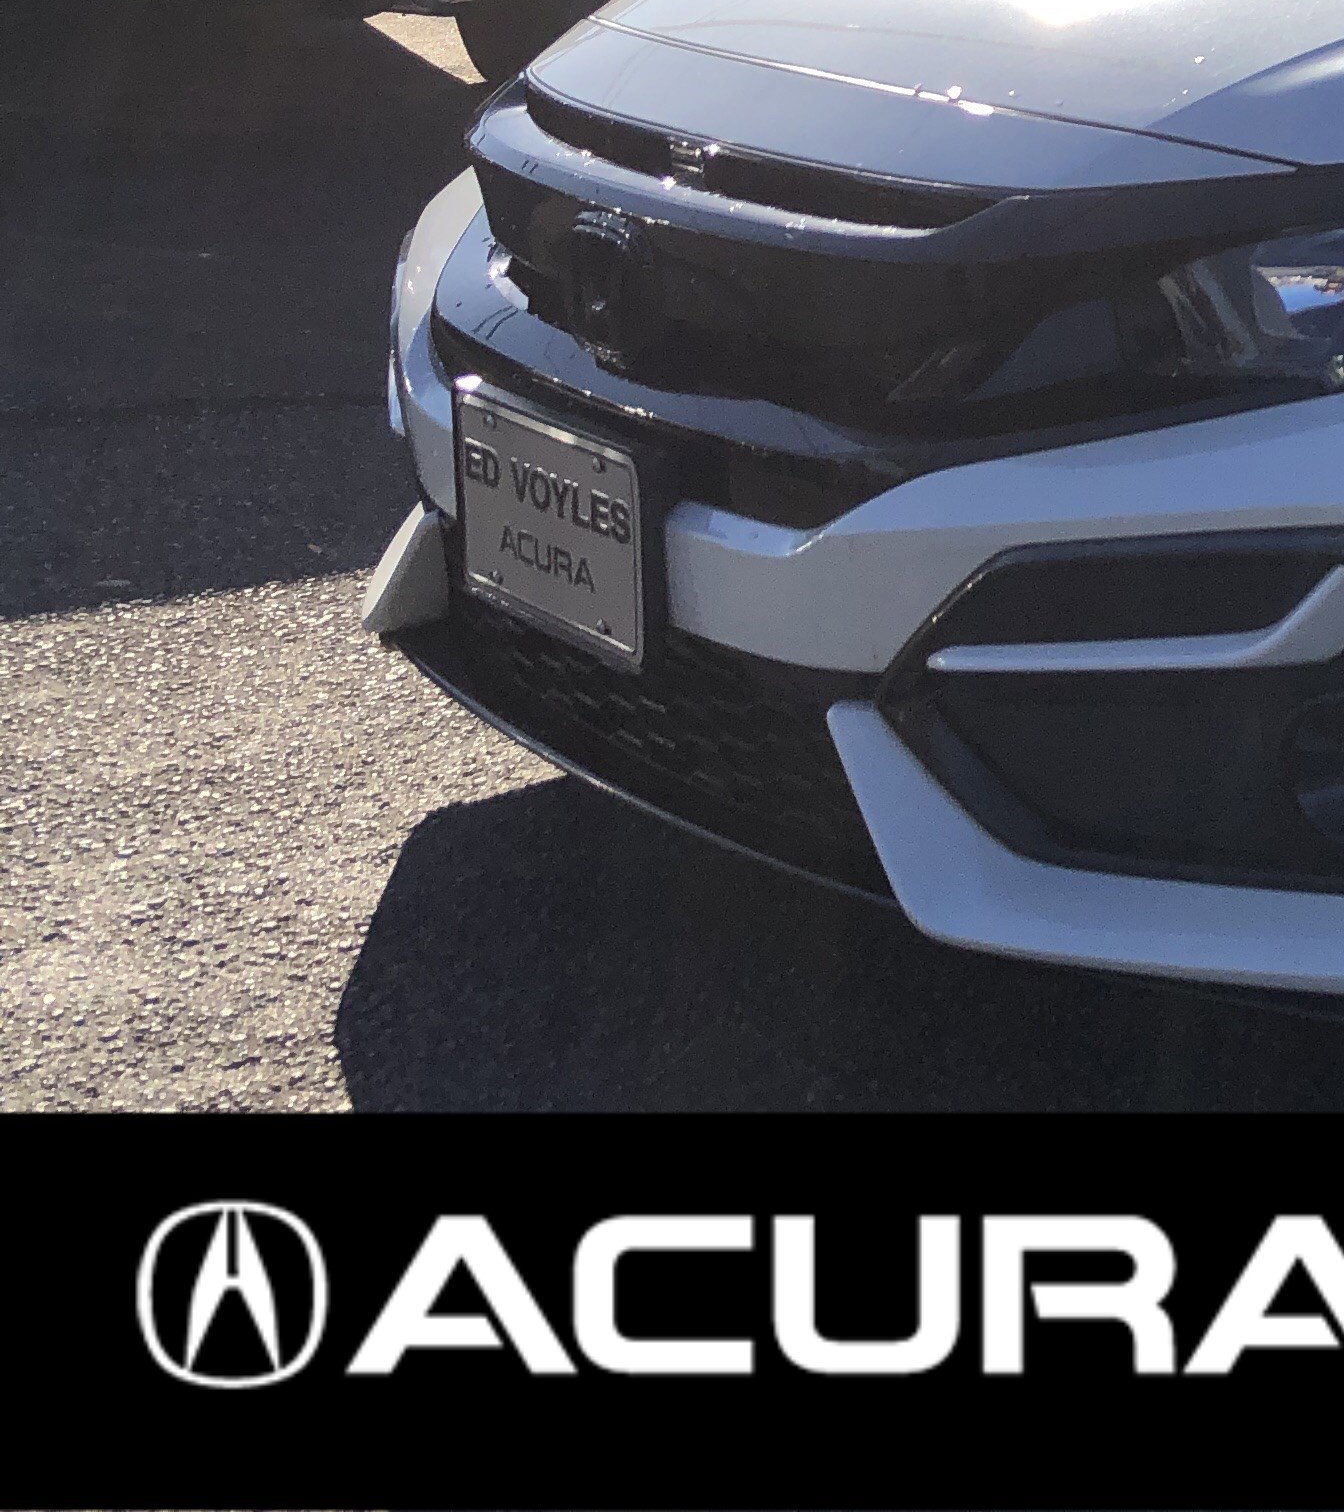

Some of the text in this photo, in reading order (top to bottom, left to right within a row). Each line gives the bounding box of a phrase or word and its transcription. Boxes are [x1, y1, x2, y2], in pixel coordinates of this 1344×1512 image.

[464, 436, 632, 545] ED VOYLES
[499, 523, 597, 595] ACURA
